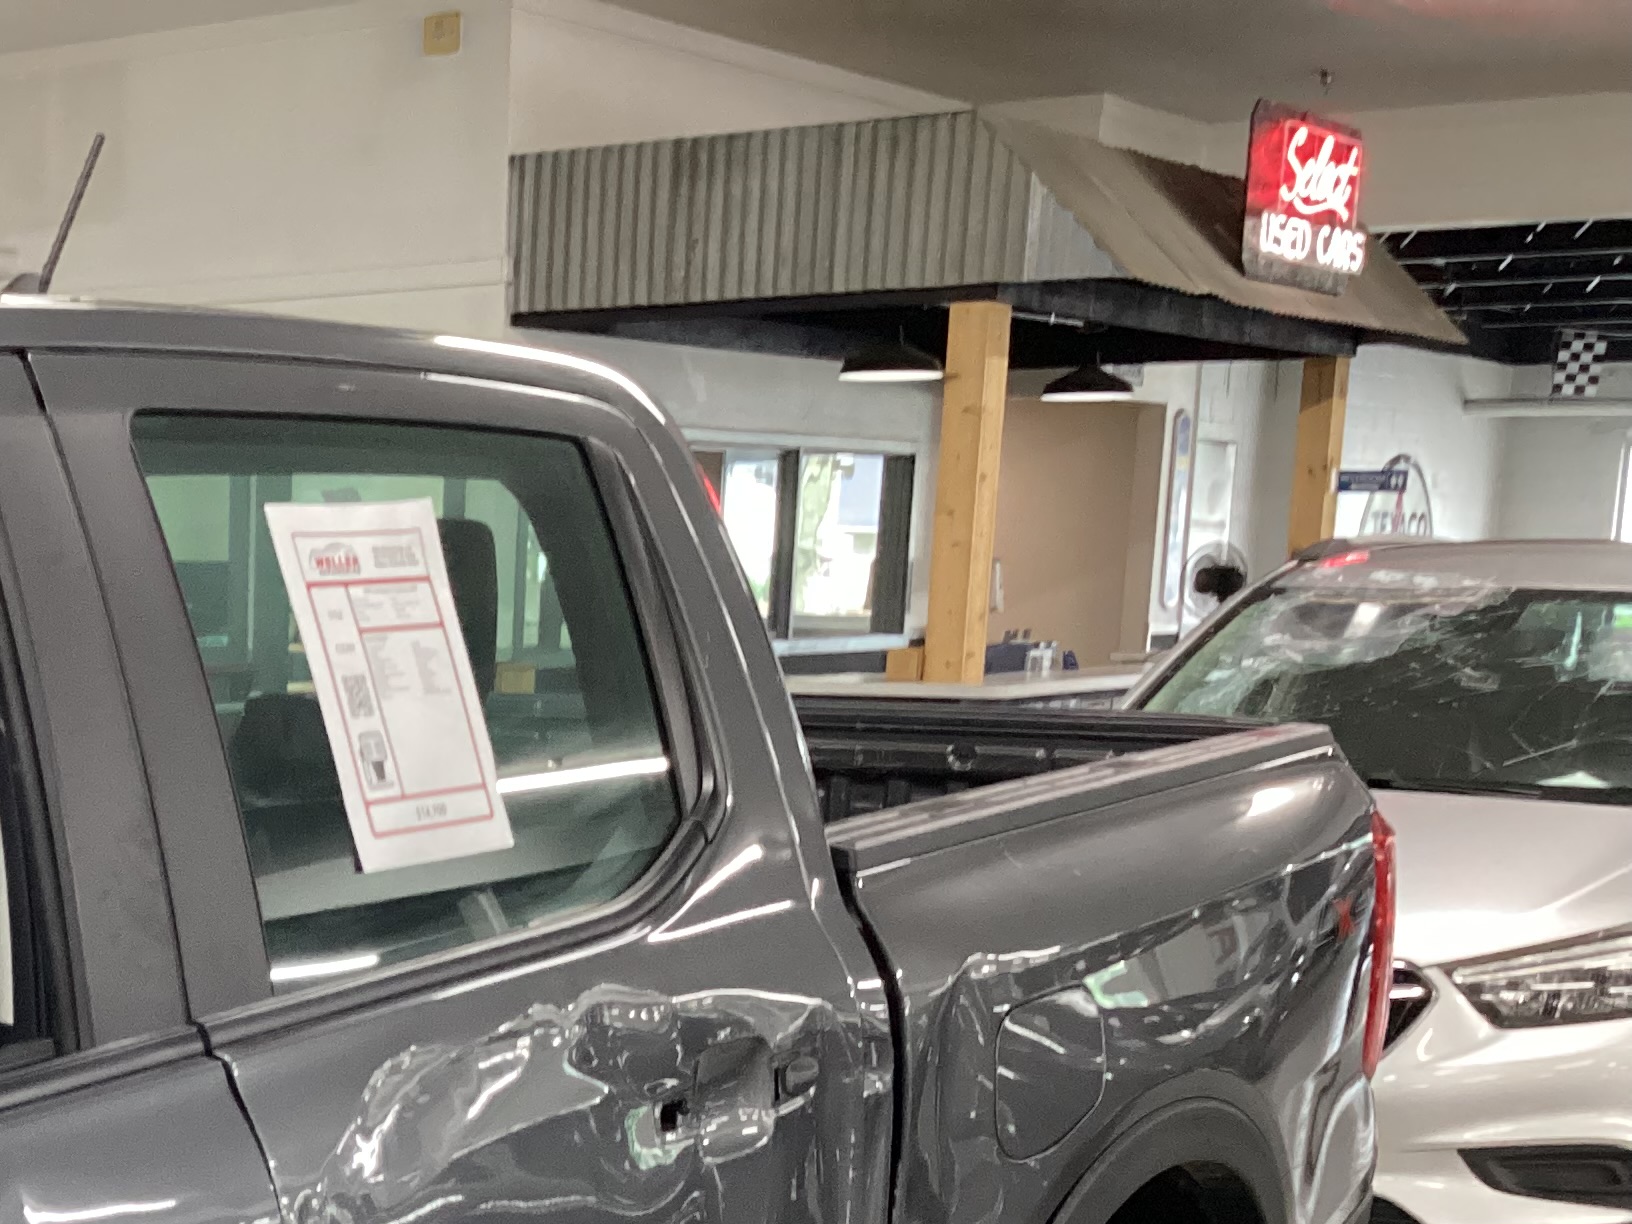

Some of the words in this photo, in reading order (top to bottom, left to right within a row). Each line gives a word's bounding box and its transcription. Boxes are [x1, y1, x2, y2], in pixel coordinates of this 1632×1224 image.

[1280, 126, 1359, 222] Select
[1259, 210, 1312, 260] USED
[1316, 224, 1367, 272] CARS
